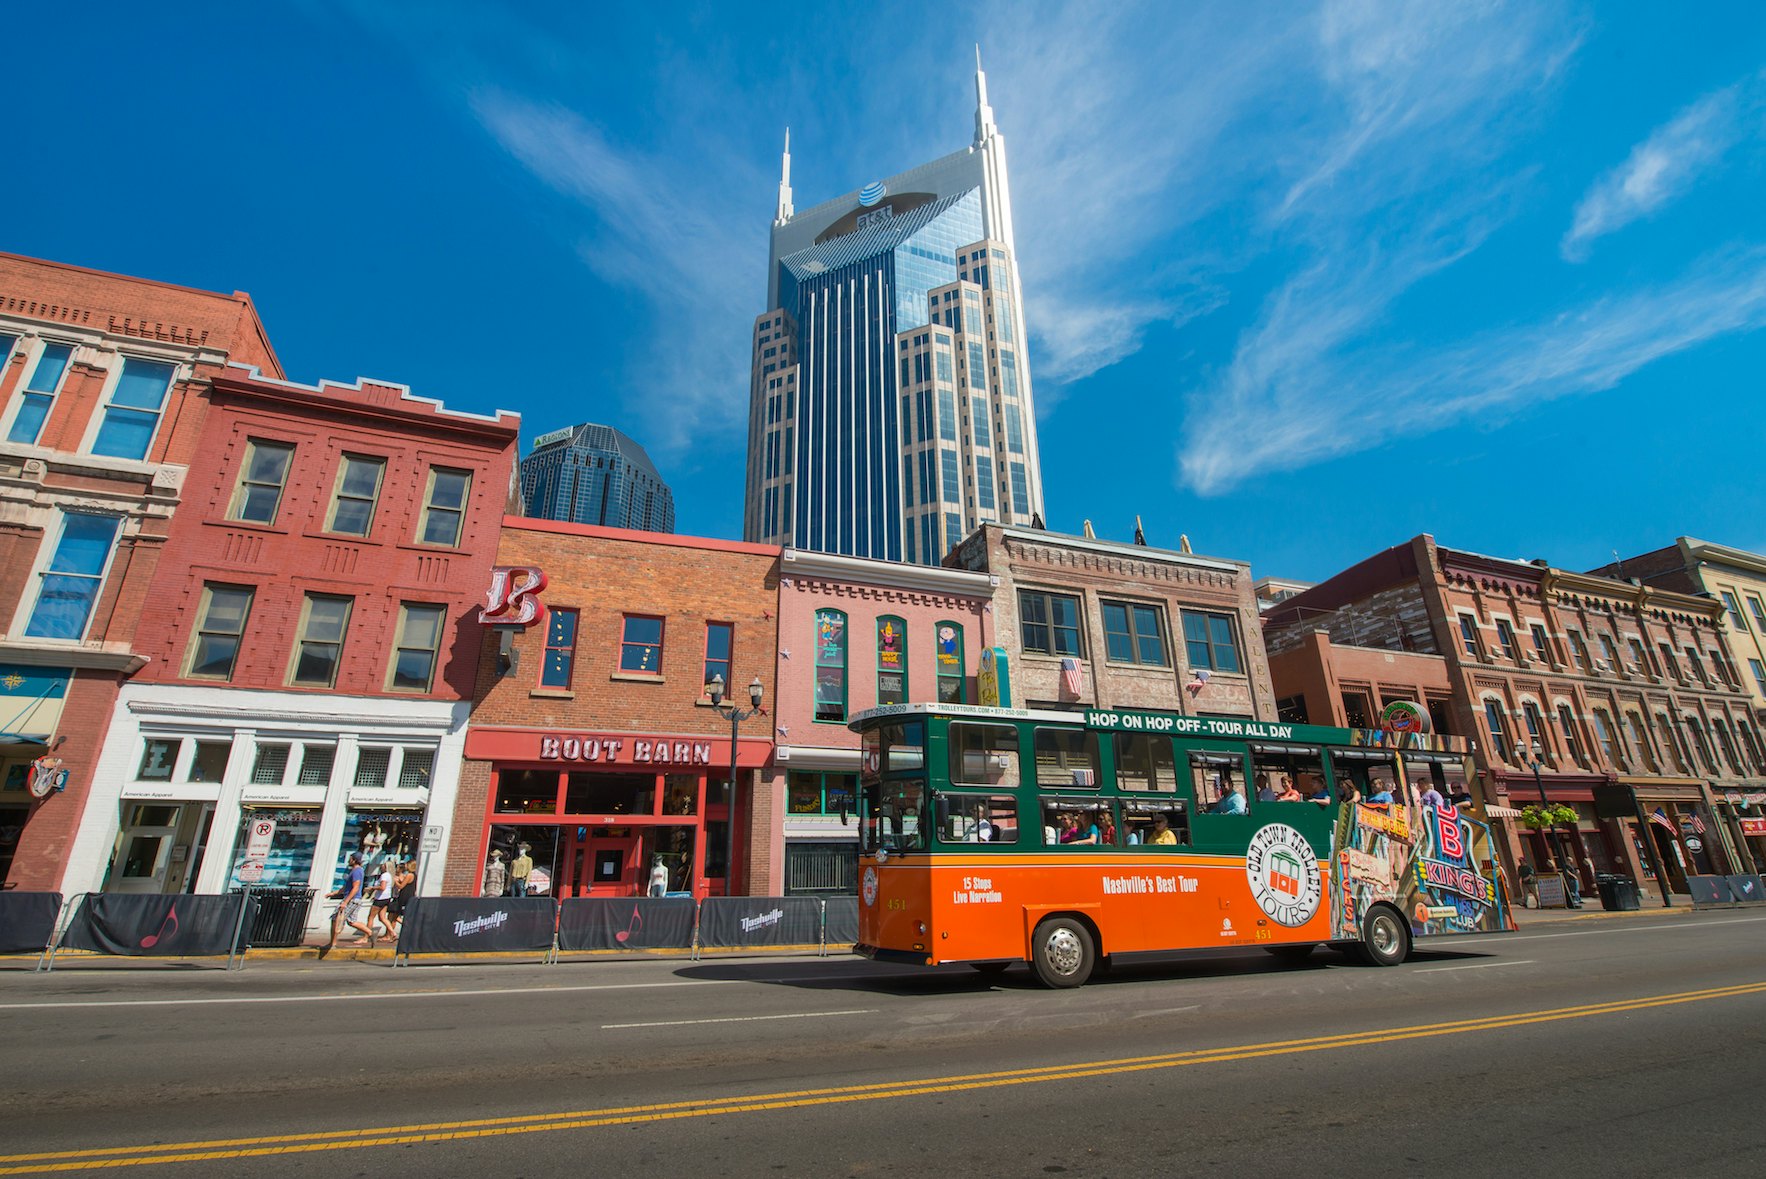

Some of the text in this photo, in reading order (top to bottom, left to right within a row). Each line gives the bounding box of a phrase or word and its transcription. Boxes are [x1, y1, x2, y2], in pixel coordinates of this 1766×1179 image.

[858, 206, 891, 228] at&t
[938, 704, 990, 714] TROLLEYTOURS.COM
[1089, 712, 1119, 727] HOP
[1122, 714, 1142, 729] ON
[1146, 716, 1173, 730] HOP
[1245, 723, 1268, 737] ALL
[1269, 725, 1292, 739] DAY
[540, 735, 711, 765] BOOT BARN
[1248, 844, 1263, 872] OLD
[1256, 825, 1287, 849] TOWN
[1290, 832, 1320, 897] TROLLEY
[963, 876, 992, 891] 15 Stops
[1102, 875, 1199, 894] Nashville's Best Tour
[1425, 861, 1486, 900] KING'S
[888, 898, 906, 910] 451
[953, 890, 1002, 904] Live Narration
[1256, 883, 1311, 925] TOURS
[453, 910, 508, 937] Nashville
[740, 908, 784, 932] Nashville
[1255, 929, 1272, 940] 451
